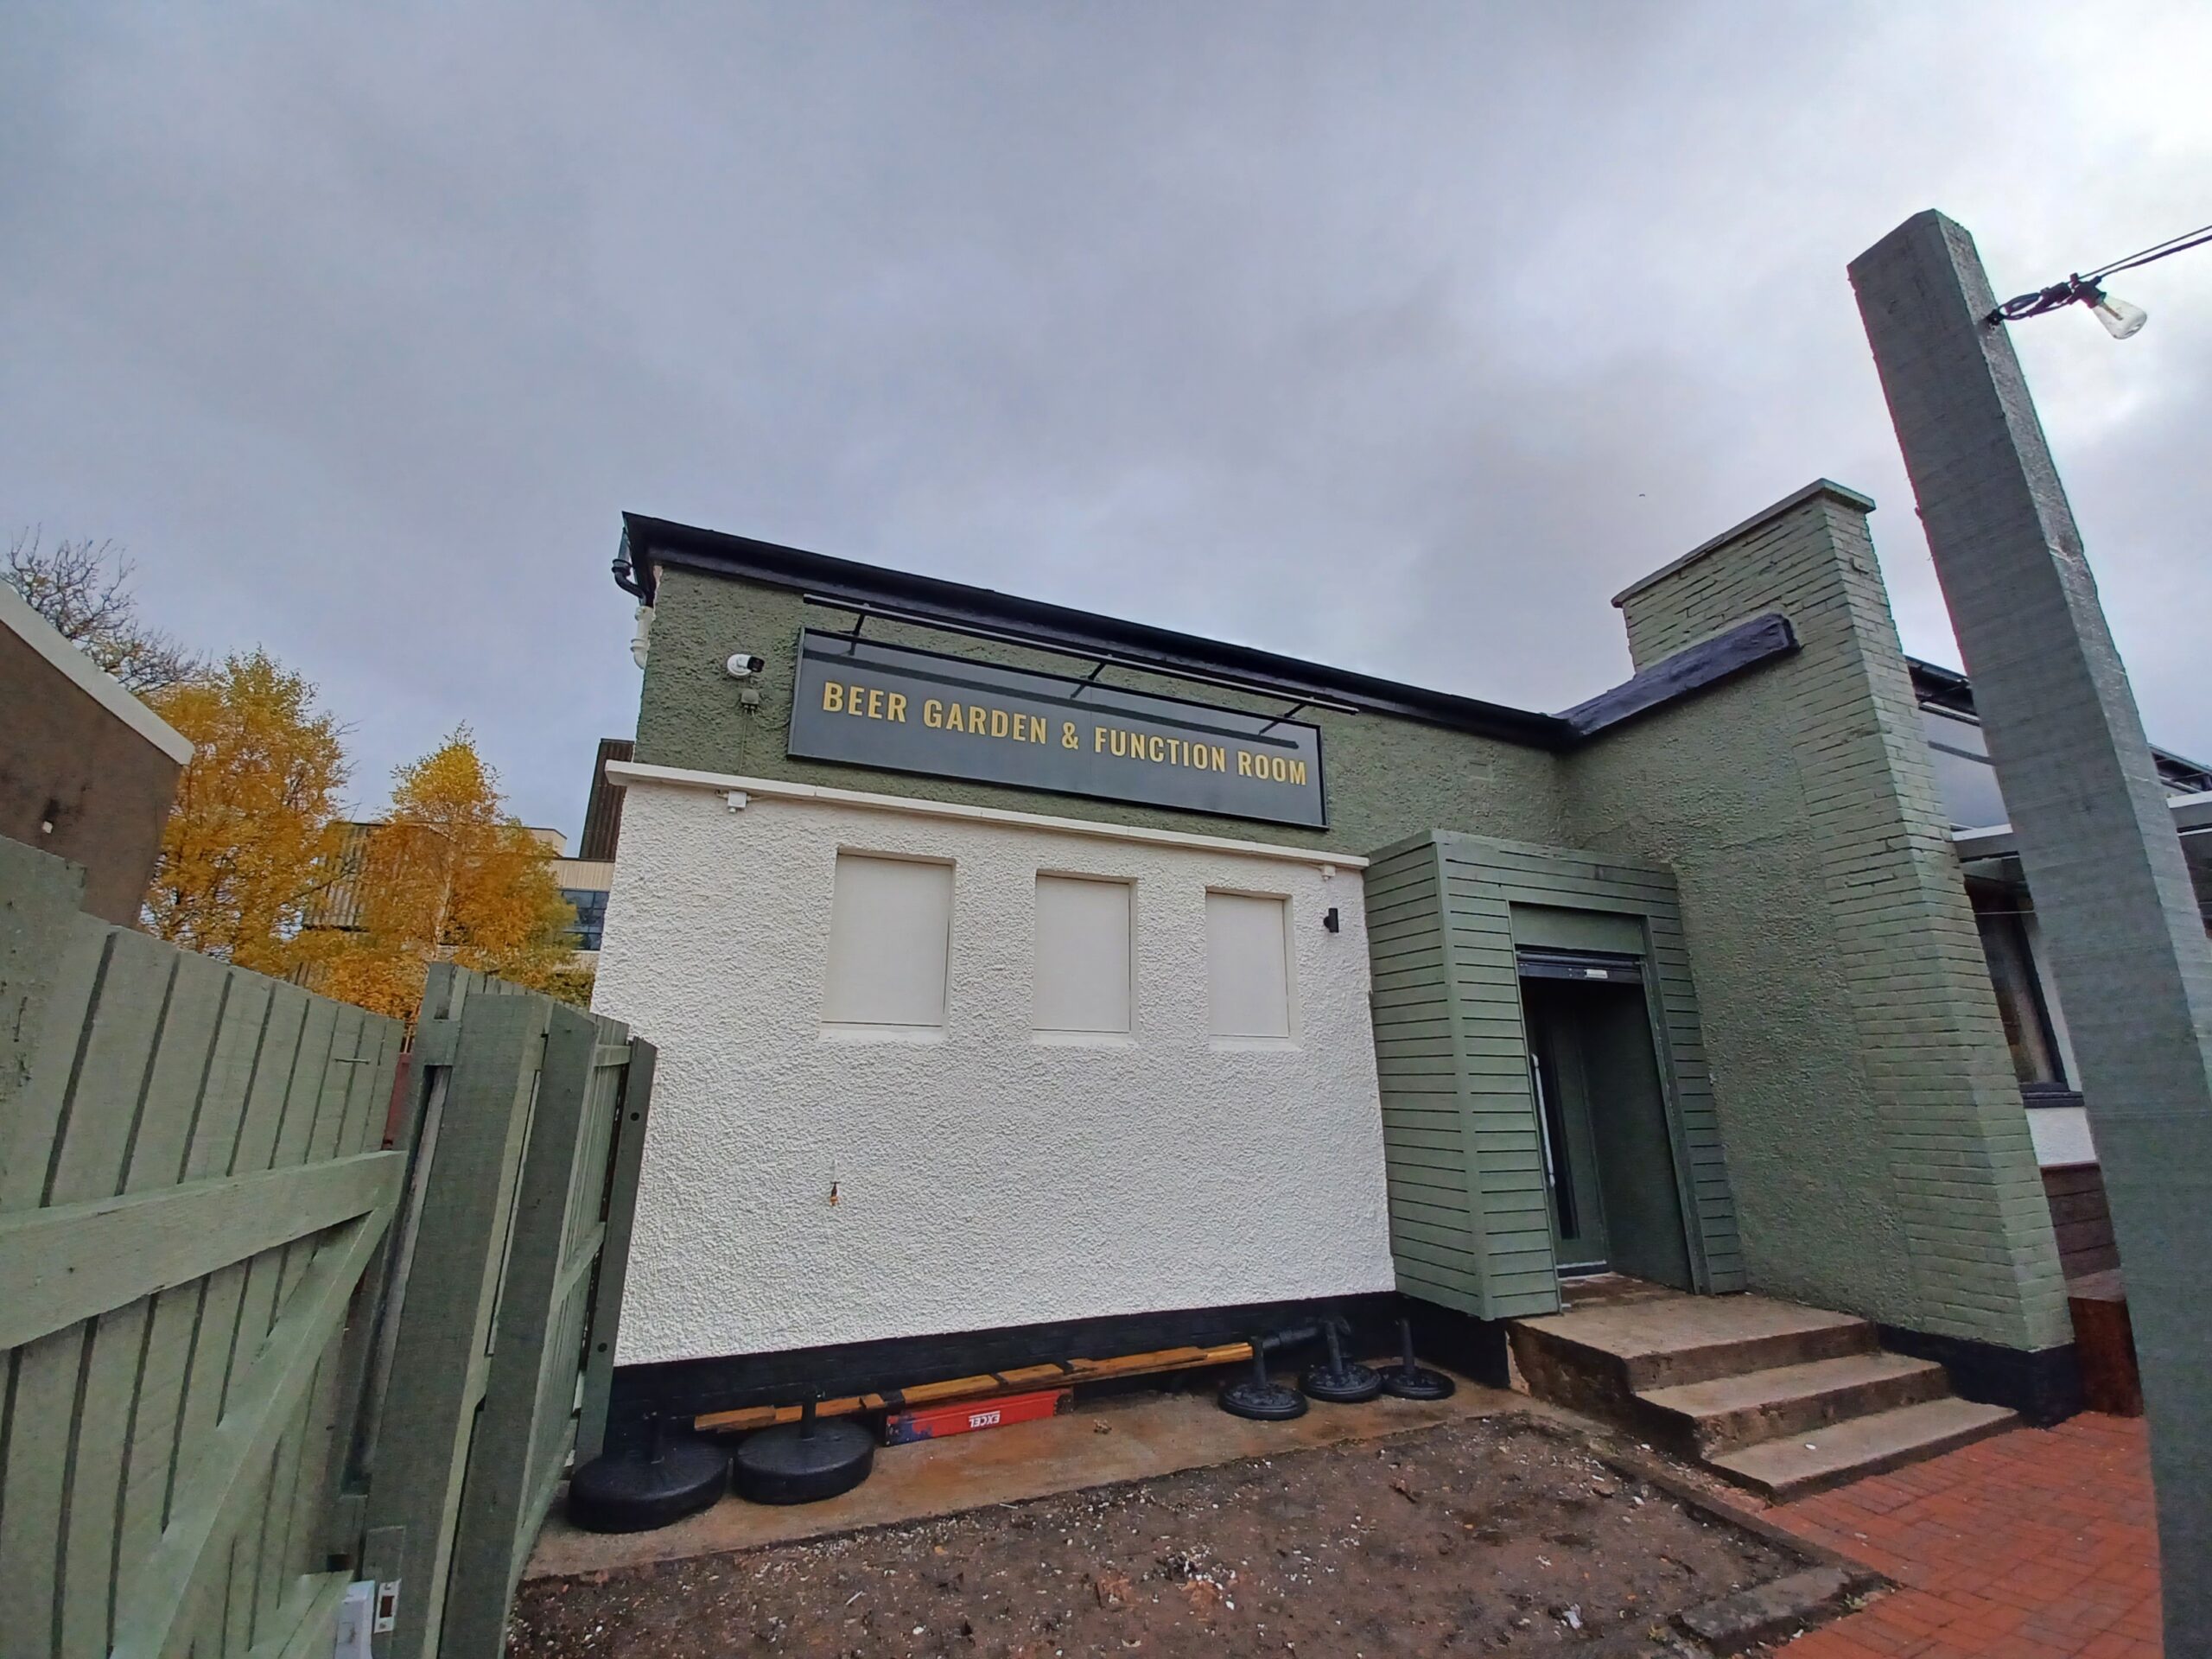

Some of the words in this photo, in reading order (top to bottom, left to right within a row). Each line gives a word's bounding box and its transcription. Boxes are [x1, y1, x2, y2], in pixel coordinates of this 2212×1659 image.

[823, 681, 906, 722] BEER
[924, 700, 1047, 744] GARDEN
[1061, 722, 1079, 749] &
[1095, 728, 1226, 772] FUNCTION
[1238, 751, 1307, 785] ROOM
[969, 1413, 1001, 1428] EXCEL
